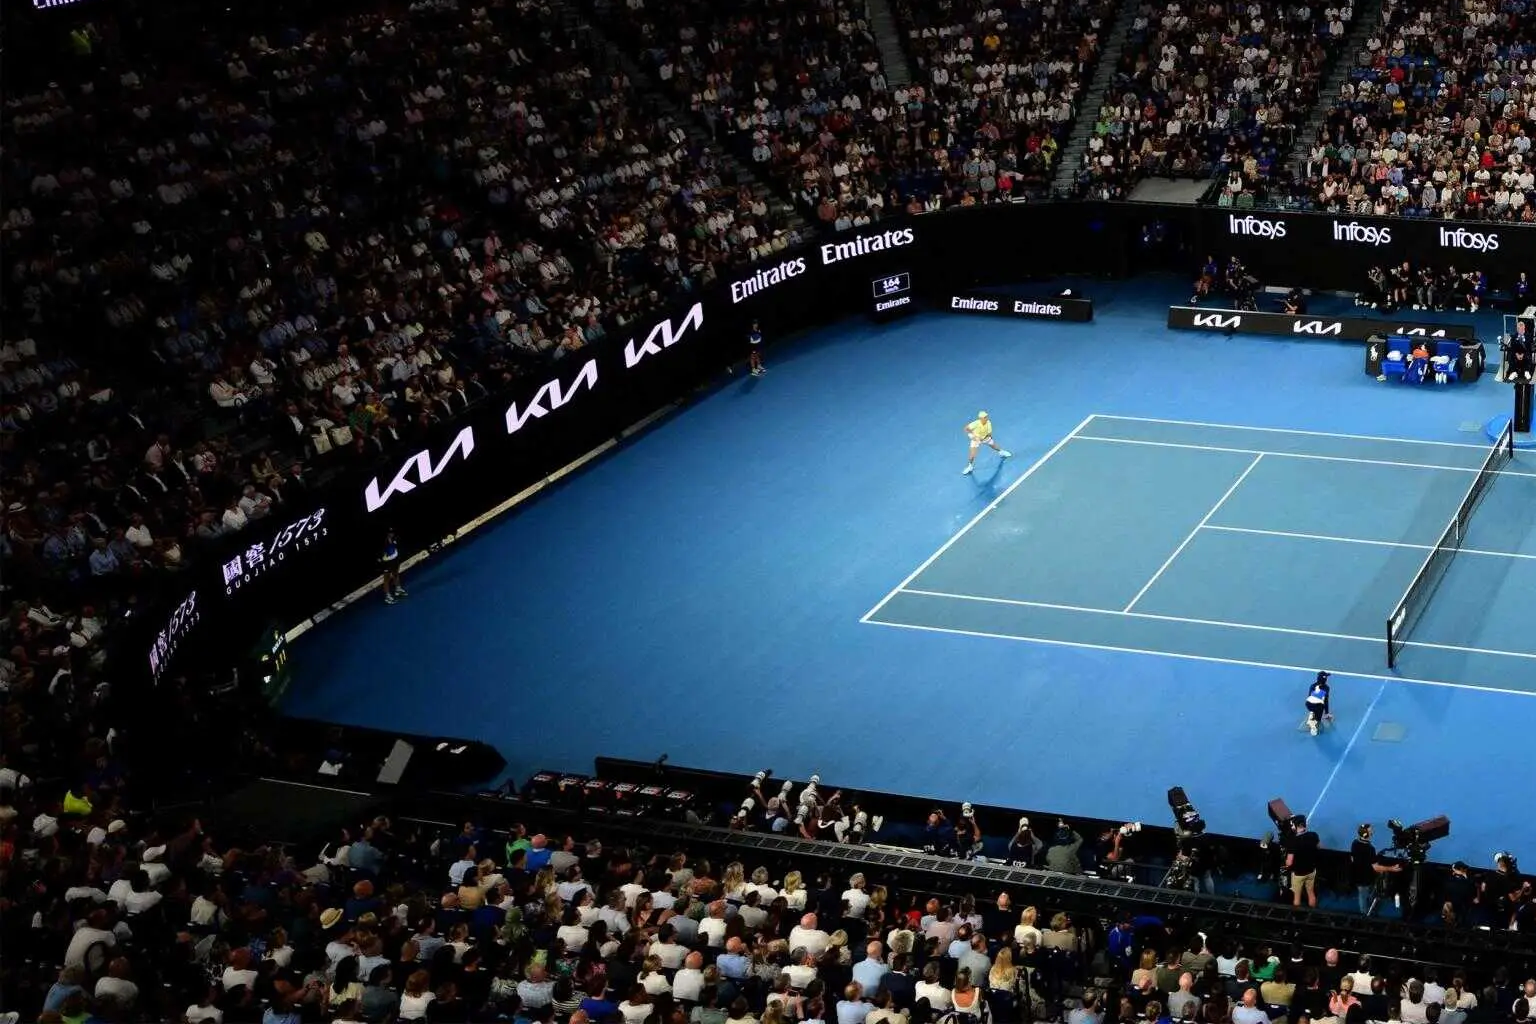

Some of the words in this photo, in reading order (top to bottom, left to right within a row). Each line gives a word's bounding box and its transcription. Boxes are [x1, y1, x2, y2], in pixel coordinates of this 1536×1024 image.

[1230, 214, 1286, 240] Infosys
[1334, 220, 1391, 246] Infosys
[1440, 226, 1499, 252] Infosys
[820, 226, 914, 266] Emirates
[730, 256, 806, 304] Emirates
[882, 278, 900, 289] 164
[876, 296, 911, 312] Emirates
[951, 296, 1000, 311] Emirates
[1014, 300, 1062, 316] Emirates
[226, 552, 284, 595] GUOJIAO
